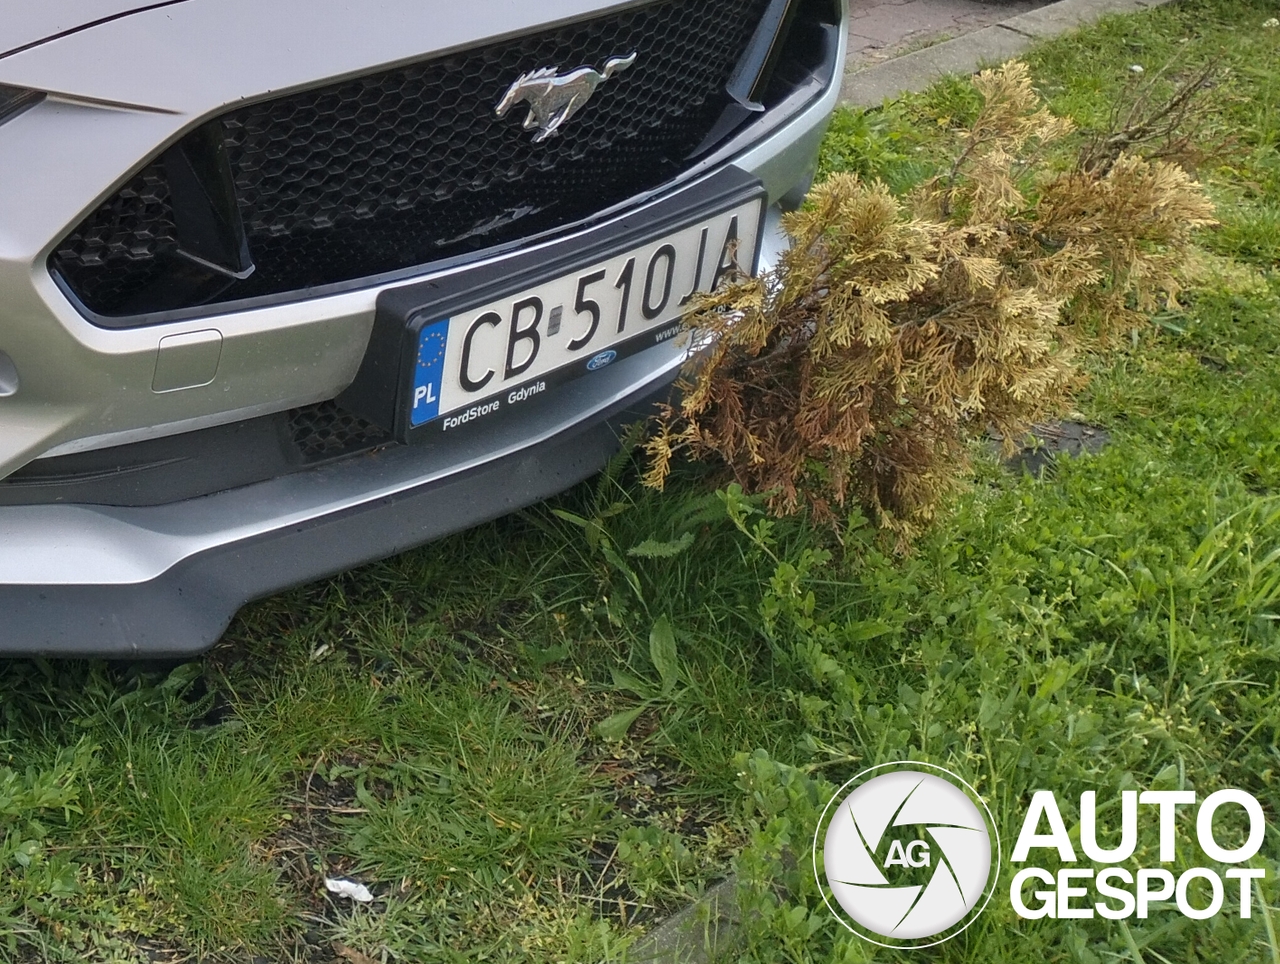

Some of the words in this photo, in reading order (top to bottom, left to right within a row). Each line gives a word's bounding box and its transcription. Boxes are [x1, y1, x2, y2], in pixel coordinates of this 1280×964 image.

[458, 295, 544, 393] CB
[567, 214, 739, 352] 510JA
[413, 382, 437, 409] PL
[442, 399, 500, 432] FordStore
[507, 380, 546, 405] Gdynia
